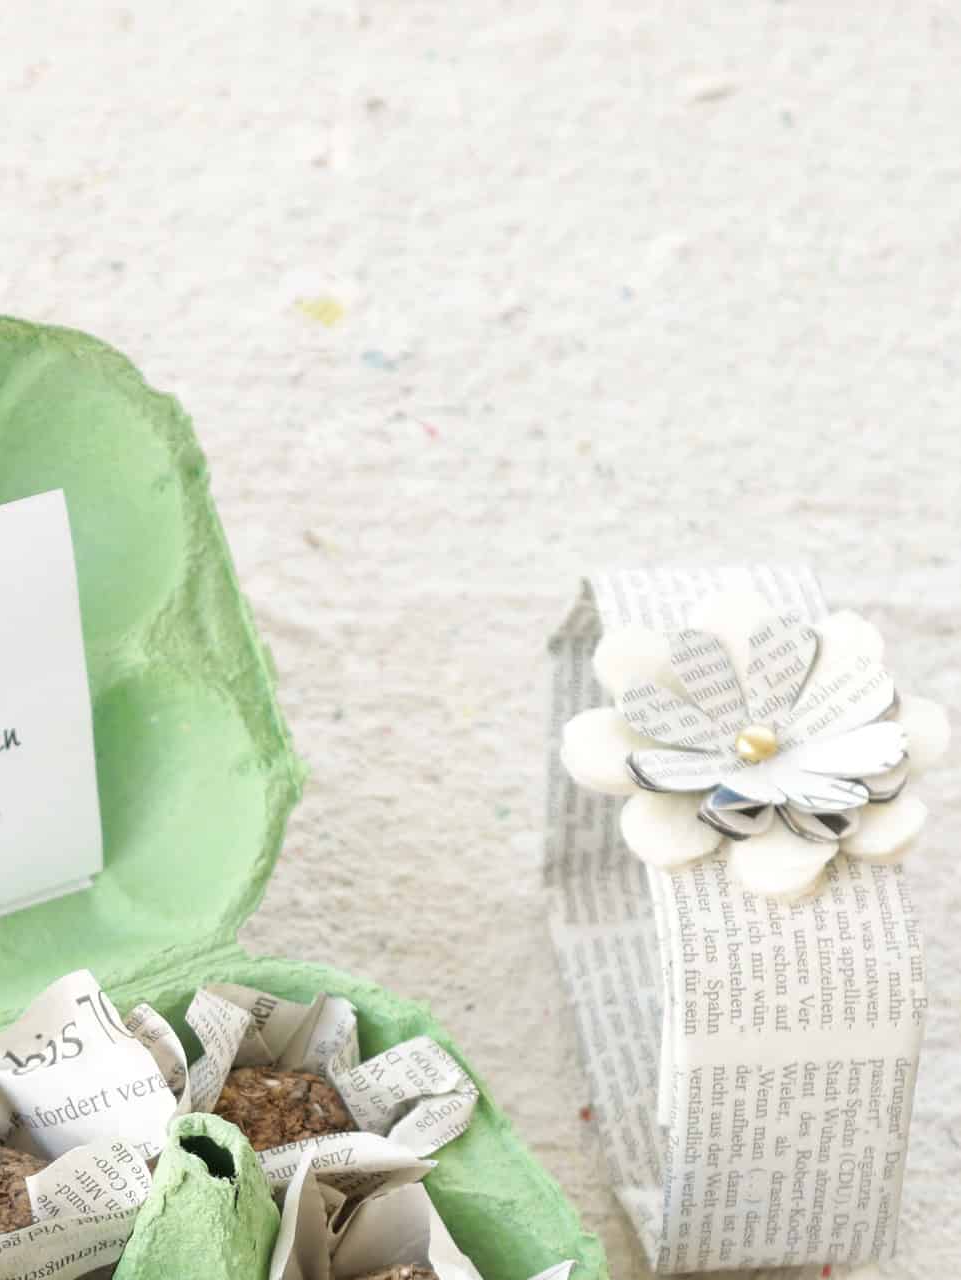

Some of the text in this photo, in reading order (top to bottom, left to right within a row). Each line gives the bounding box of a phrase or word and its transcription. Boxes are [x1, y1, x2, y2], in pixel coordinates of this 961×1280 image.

[837, 911, 852, 941] und
[684, 968, 700, 994] für
[773, 945, 791, 1032] schon auf
[684, 1000, 698, 1035] sein
[703, 979, 722, 1034] Spahn
[711, 1065, 726, 1107] nicht
[734, 1064, 751, 1092] der
[823, 1060, 842, 1102] Stadt
[846, 1059, 866, 1094] Jens
[709, 1112, 724, 1138] aus
[799, 1111, 814, 1137] des
[816, 1108, 839, 1163] Wuhan
[840, 1099, 860, 1147] Spahn
[706, 1143, 725, 1168] der
[751, 1127, 767, 1160] man
[774, 1136, 791, 1157] als
[679, 1171, 698, 1216] werde
[704, 1172, 721, 1209] Welt
[724, 1170, 742, 1208] dann
[743, 1211, 759, 1248] diese
